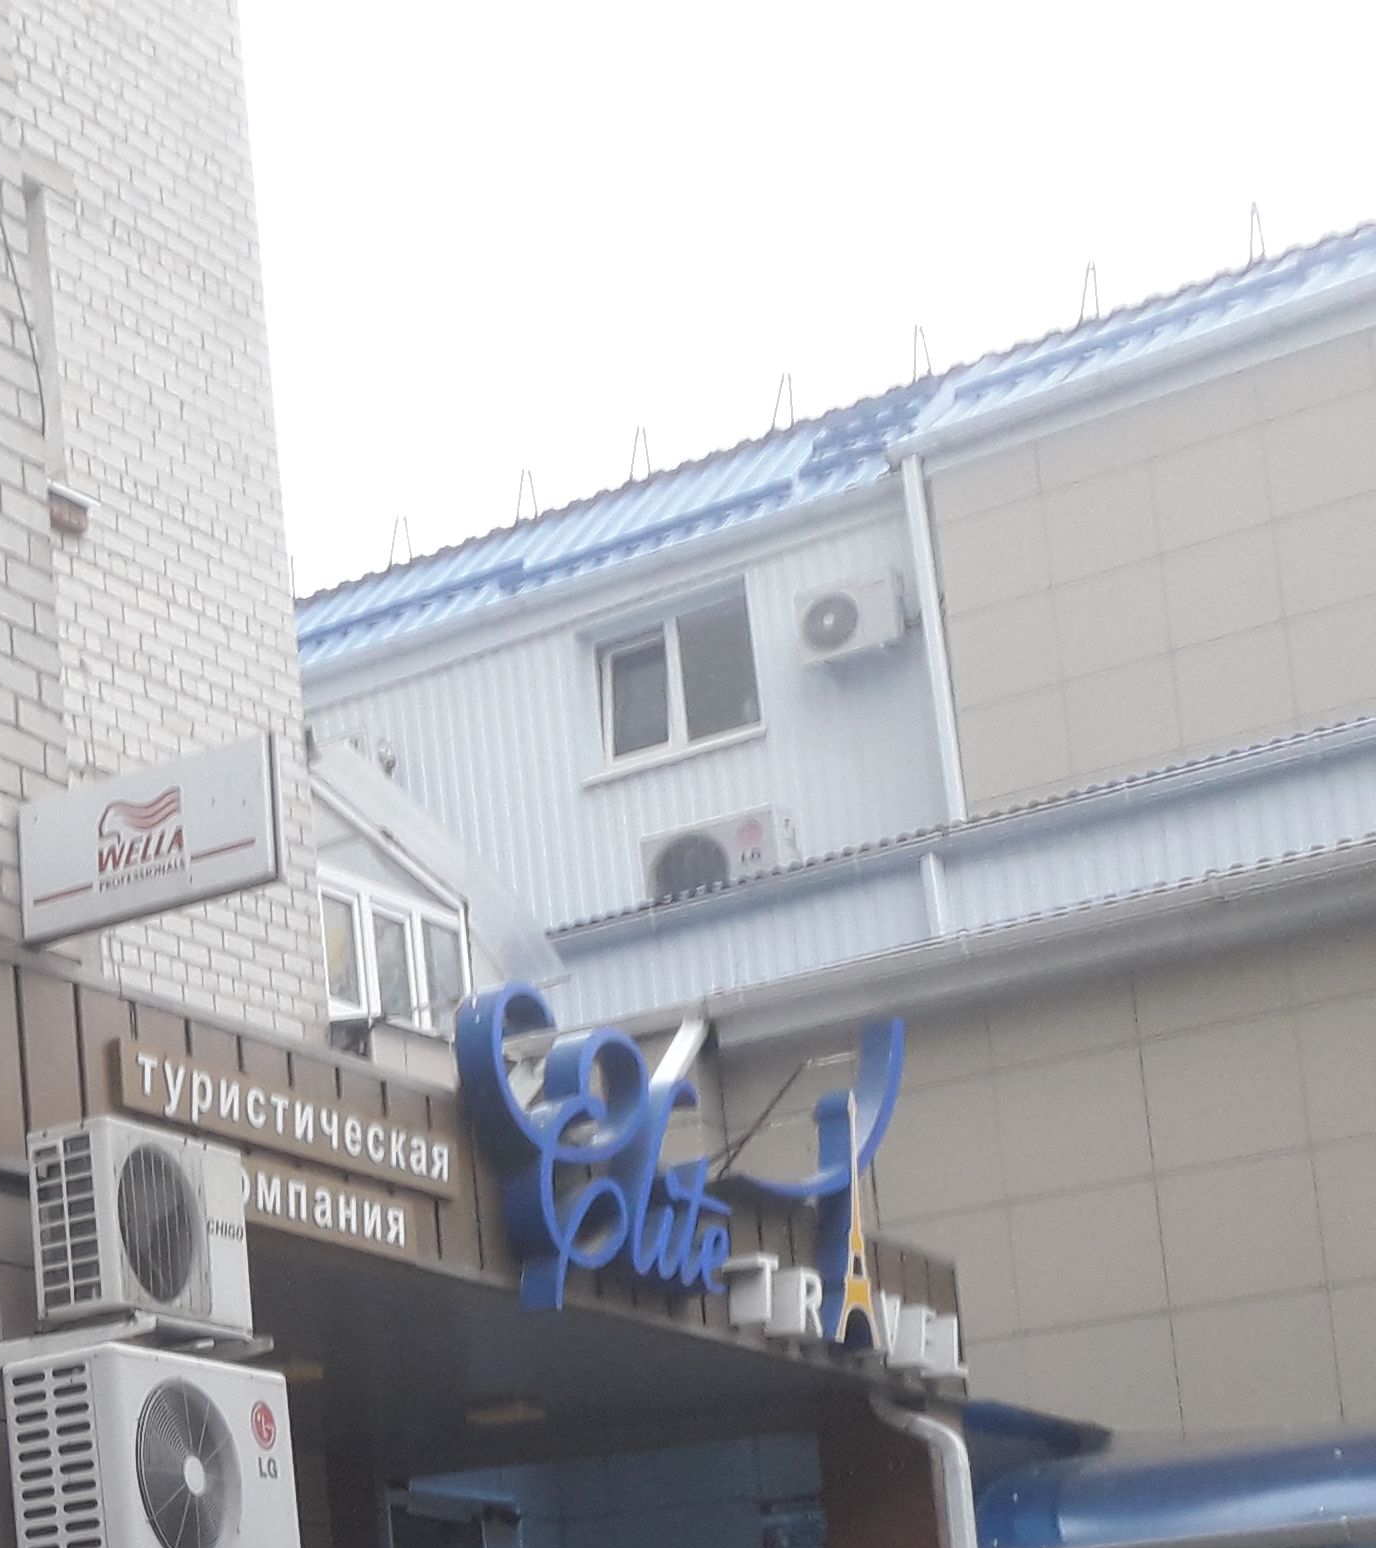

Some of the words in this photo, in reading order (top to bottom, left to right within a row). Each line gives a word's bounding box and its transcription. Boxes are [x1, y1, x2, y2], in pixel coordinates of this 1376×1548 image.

[98, 824, 183, 872] WELLA
[137, 1052, 449, 1183] туристическая
[240, 1165, 406, 1249] мпания
[258, 1456, 278, 1479] LG
